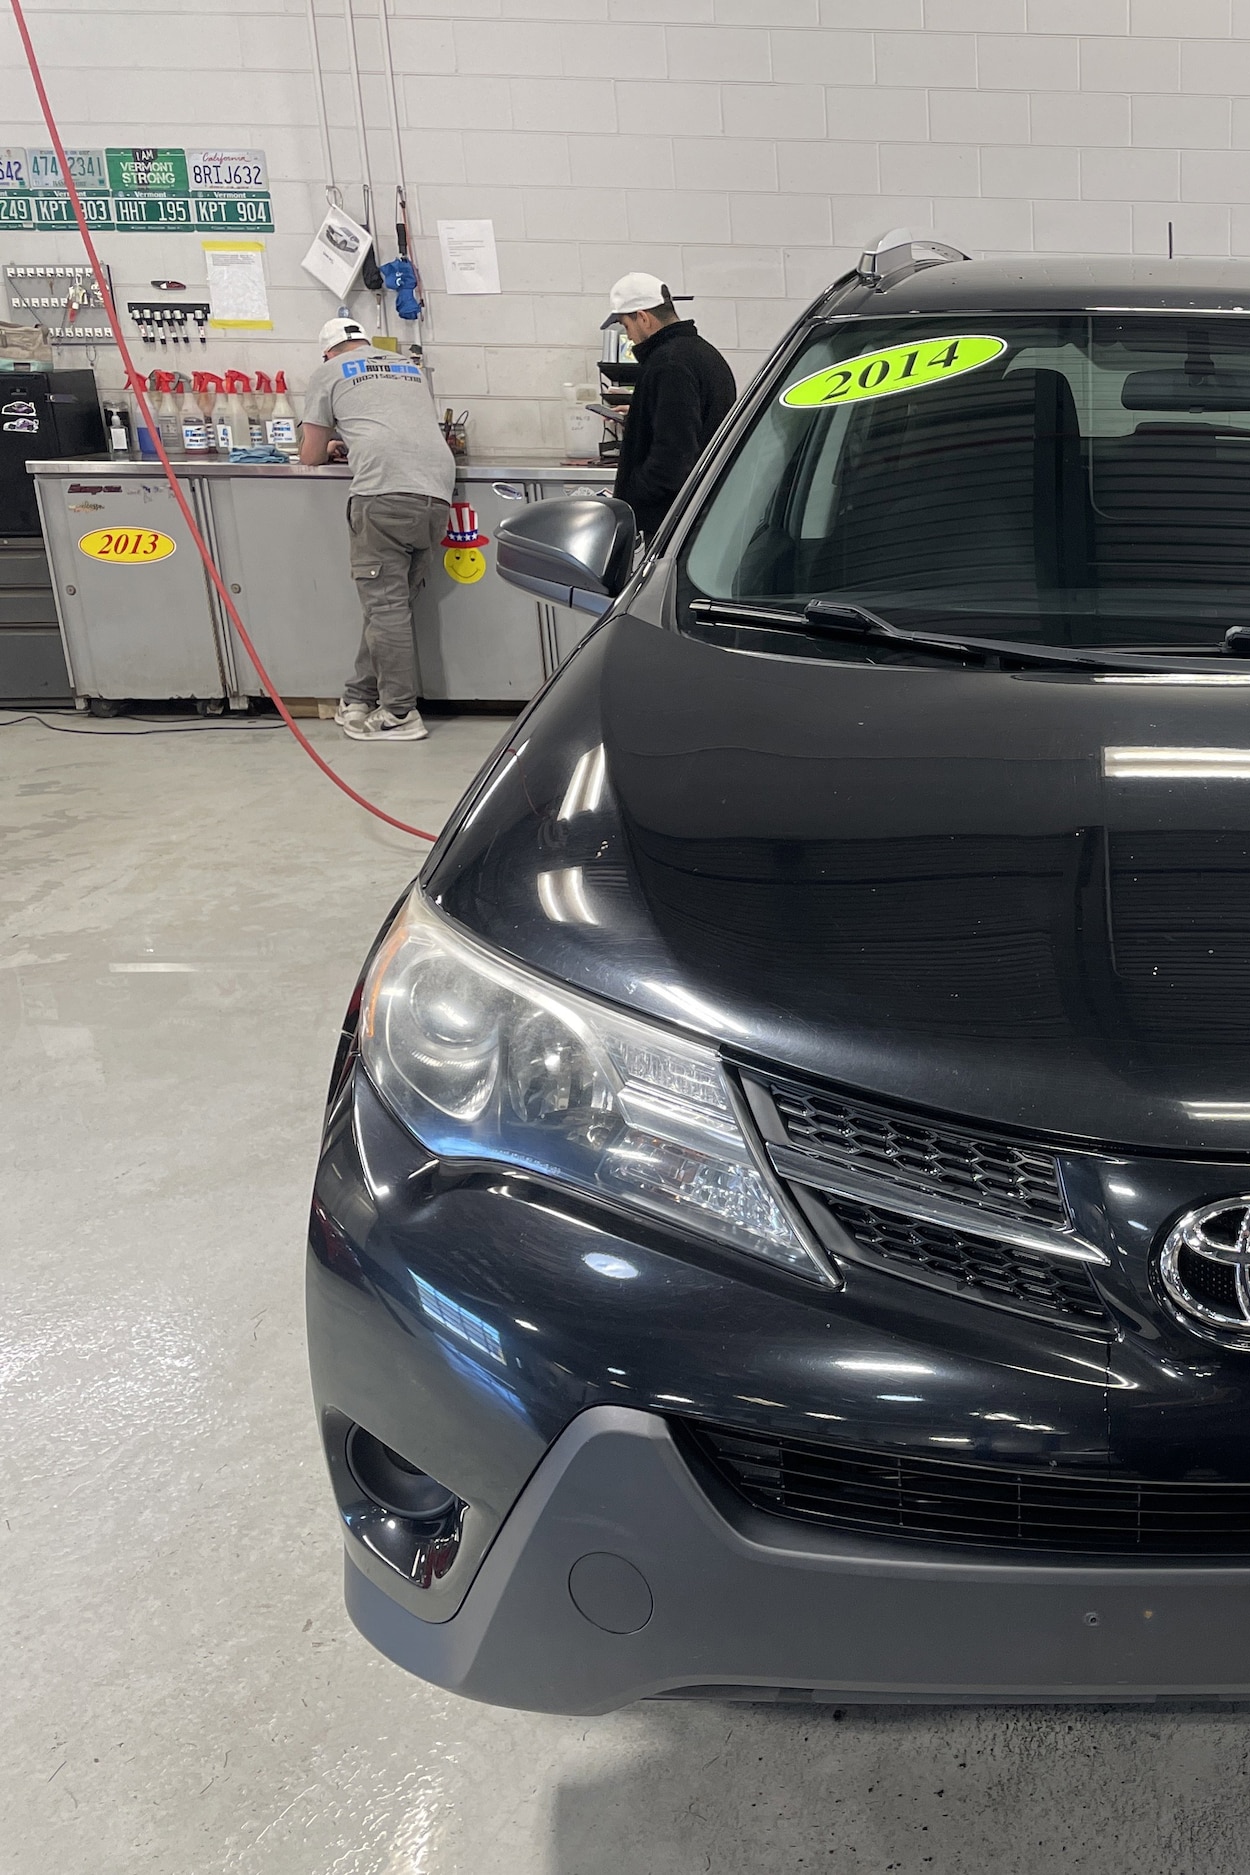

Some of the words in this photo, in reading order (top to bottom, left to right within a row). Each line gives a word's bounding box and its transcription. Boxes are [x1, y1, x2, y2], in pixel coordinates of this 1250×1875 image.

[32, 156, 58, 176] 474
[120, 162, 174, 172] VERMONT
[202, 152, 251, 164] California
[122, 172, 176, 184] STRONG
[193, 165, 262, 185] 8RIJ632
[133, 190, 167, 198] Vermont
[213, 191, 247, 199] Vermont
[40, 200, 68, 221] KPT
[119, 200, 147, 221] HHT
[157, 201, 187, 222] 195
[199, 201, 227, 222] KPT
[237, 202, 267, 222] 904
[820, 340, 960, 402] 2014
[97, 533, 160, 555] 2013
